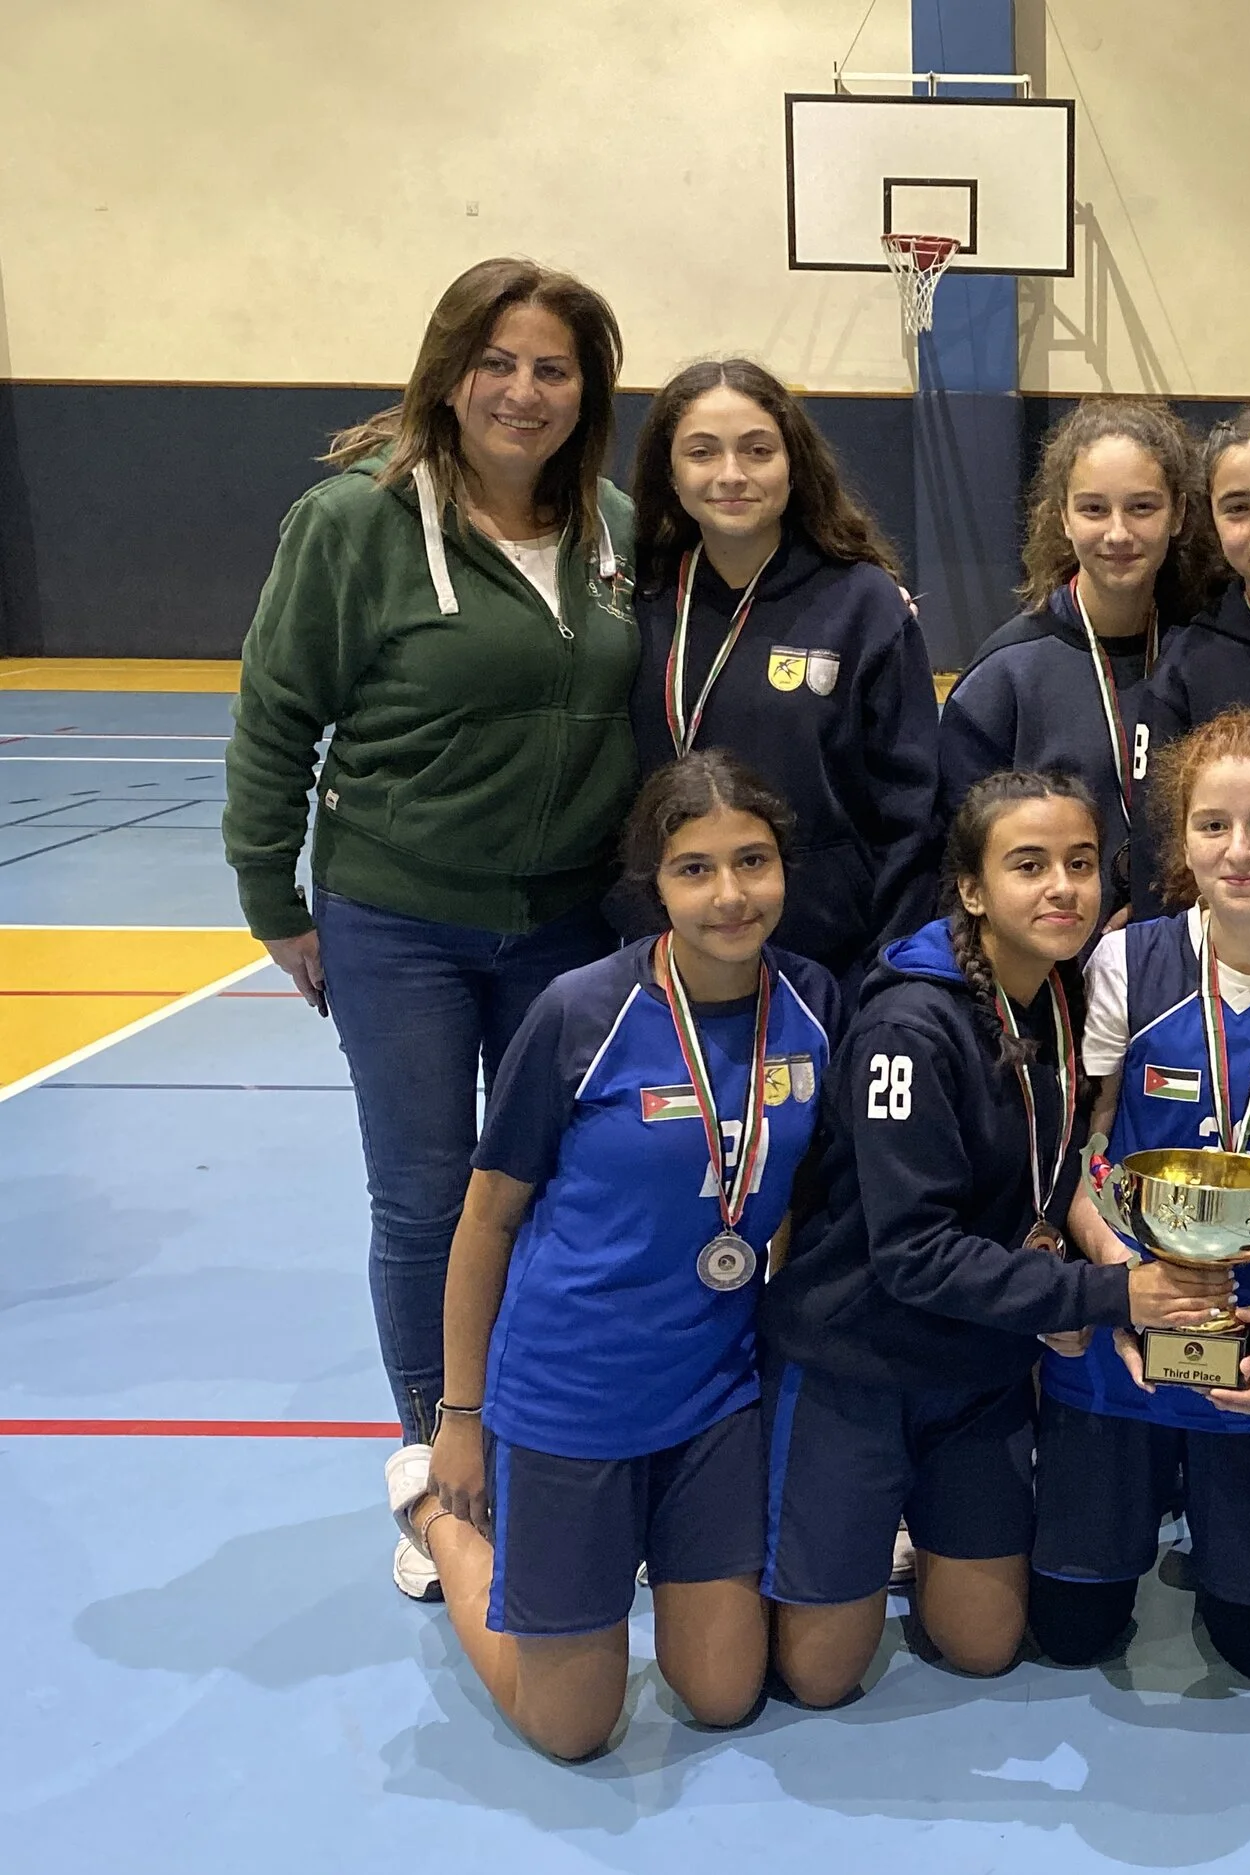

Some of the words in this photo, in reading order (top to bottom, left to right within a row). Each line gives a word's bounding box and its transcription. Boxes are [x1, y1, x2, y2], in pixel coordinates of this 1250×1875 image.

[867, 1053, 914, 1120] 28
[1163, 1367, 1190, 1379] Third
[1192, 1370, 1222, 1382] Place
